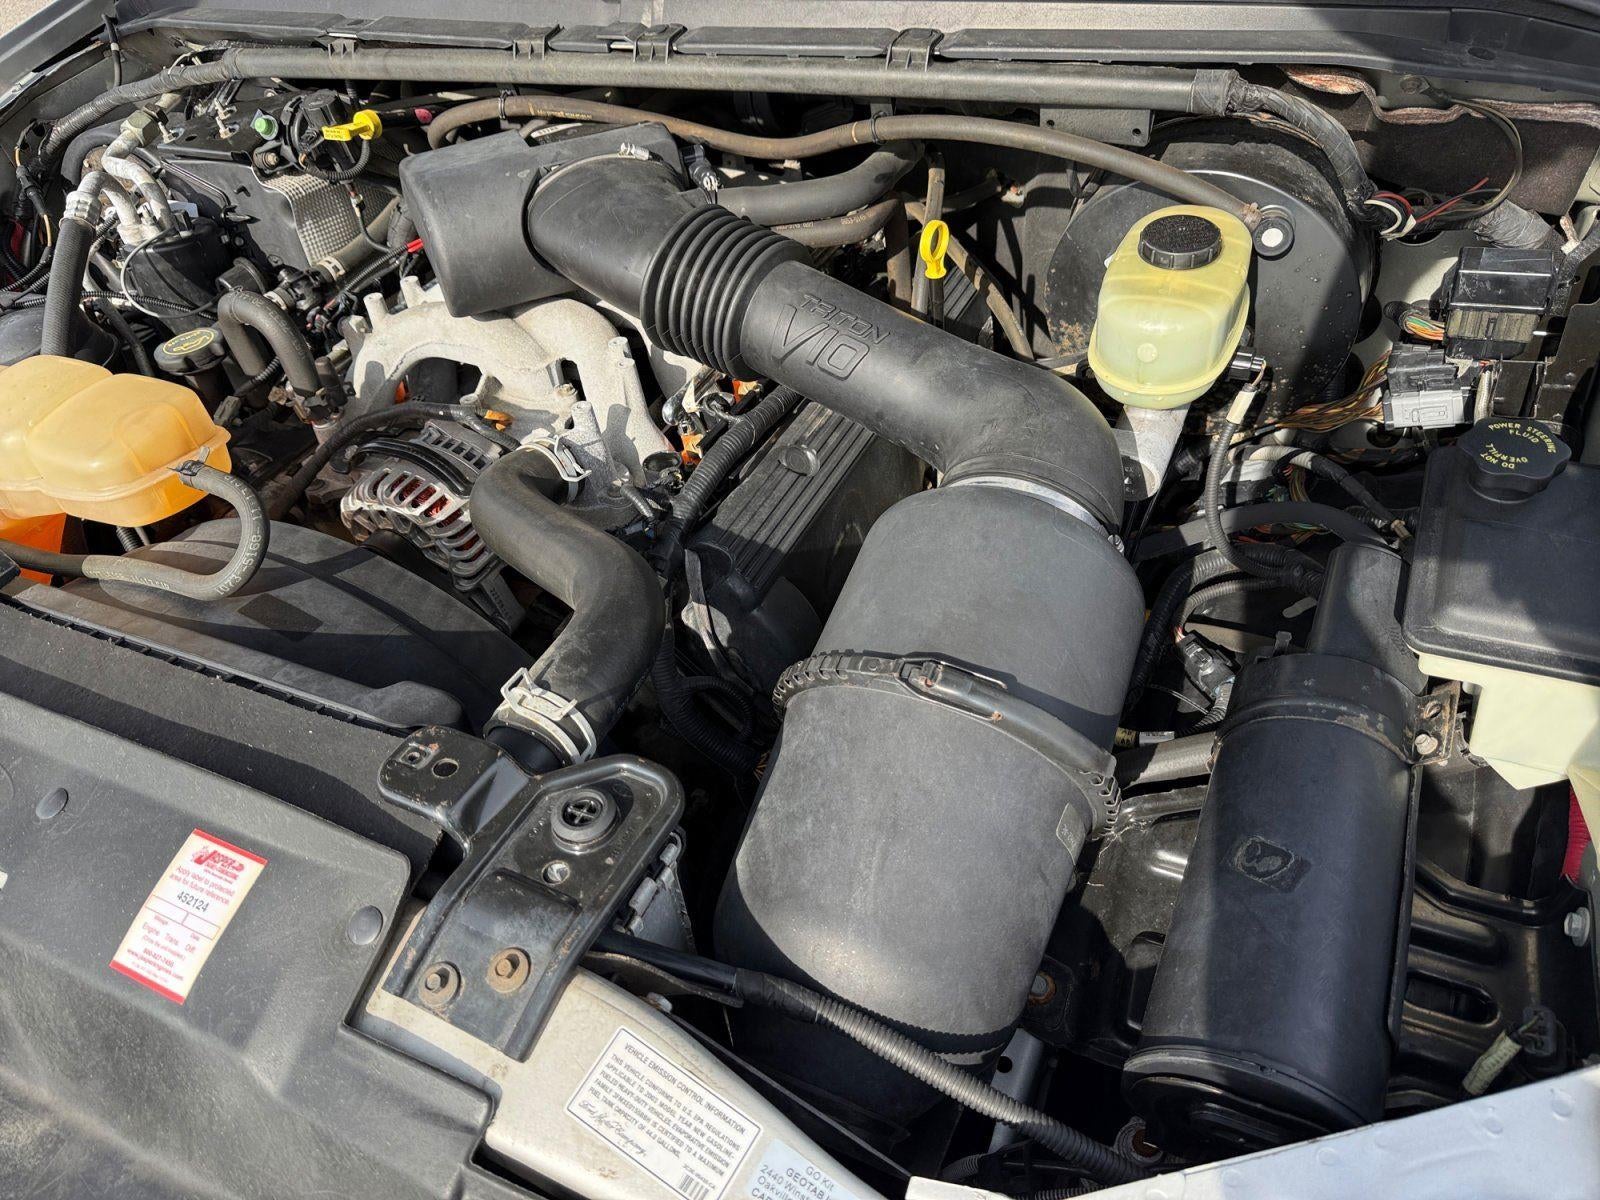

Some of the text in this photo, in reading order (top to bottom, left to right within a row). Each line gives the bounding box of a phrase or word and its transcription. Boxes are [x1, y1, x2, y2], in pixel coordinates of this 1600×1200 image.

[800, 293, 891, 344] TRITON
[771, 304, 870, 381] V10
[1488, 422, 1557, 454] POWER STEERING
[1509, 429, 1539, 443] FLUID
[1480, 452, 1499, 464] NOT
[1485, 443, 1528, 463] OVERFILL
[175, 889, 209, 913] 452124
[605, 1062, 636, 1087] APPLICABLE
[636, 1084, 644, 1093] TO
[658, 1100, 677, 1117] MODEL
[678, 1114, 692, 1128] YEAR
[693, 1125, 705, 1138] NEW
[611, 1054, 623, 1065] THIS
[624, 1063, 644, 1081] VEHICLE
[645, 1078, 673, 1102] CONFORMS
[674, 1099, 682, 1108] TO
[693, 1114, 704, 1125] EPA
[704, 1122, 740, 1151] REGULATIONS
[624, 1042, 745, 1135] VEHICLE EMISSION CONTROL INFORMATION
[589, 1086, 602, 1099] FUEL
[614, 1105, 638, 1126] CAPACITY
[658, 1125, 684, 1148] CERTIFIED
[684, 1144, 692, 1154] TO
[697, 1154, 724, 1177] MAXIMUM
[760, 1164, 784, 1185] 2440
[786, 1167, 824, 1200] GEOTAB
[806, 1166, 834, 1191] GO Kit
